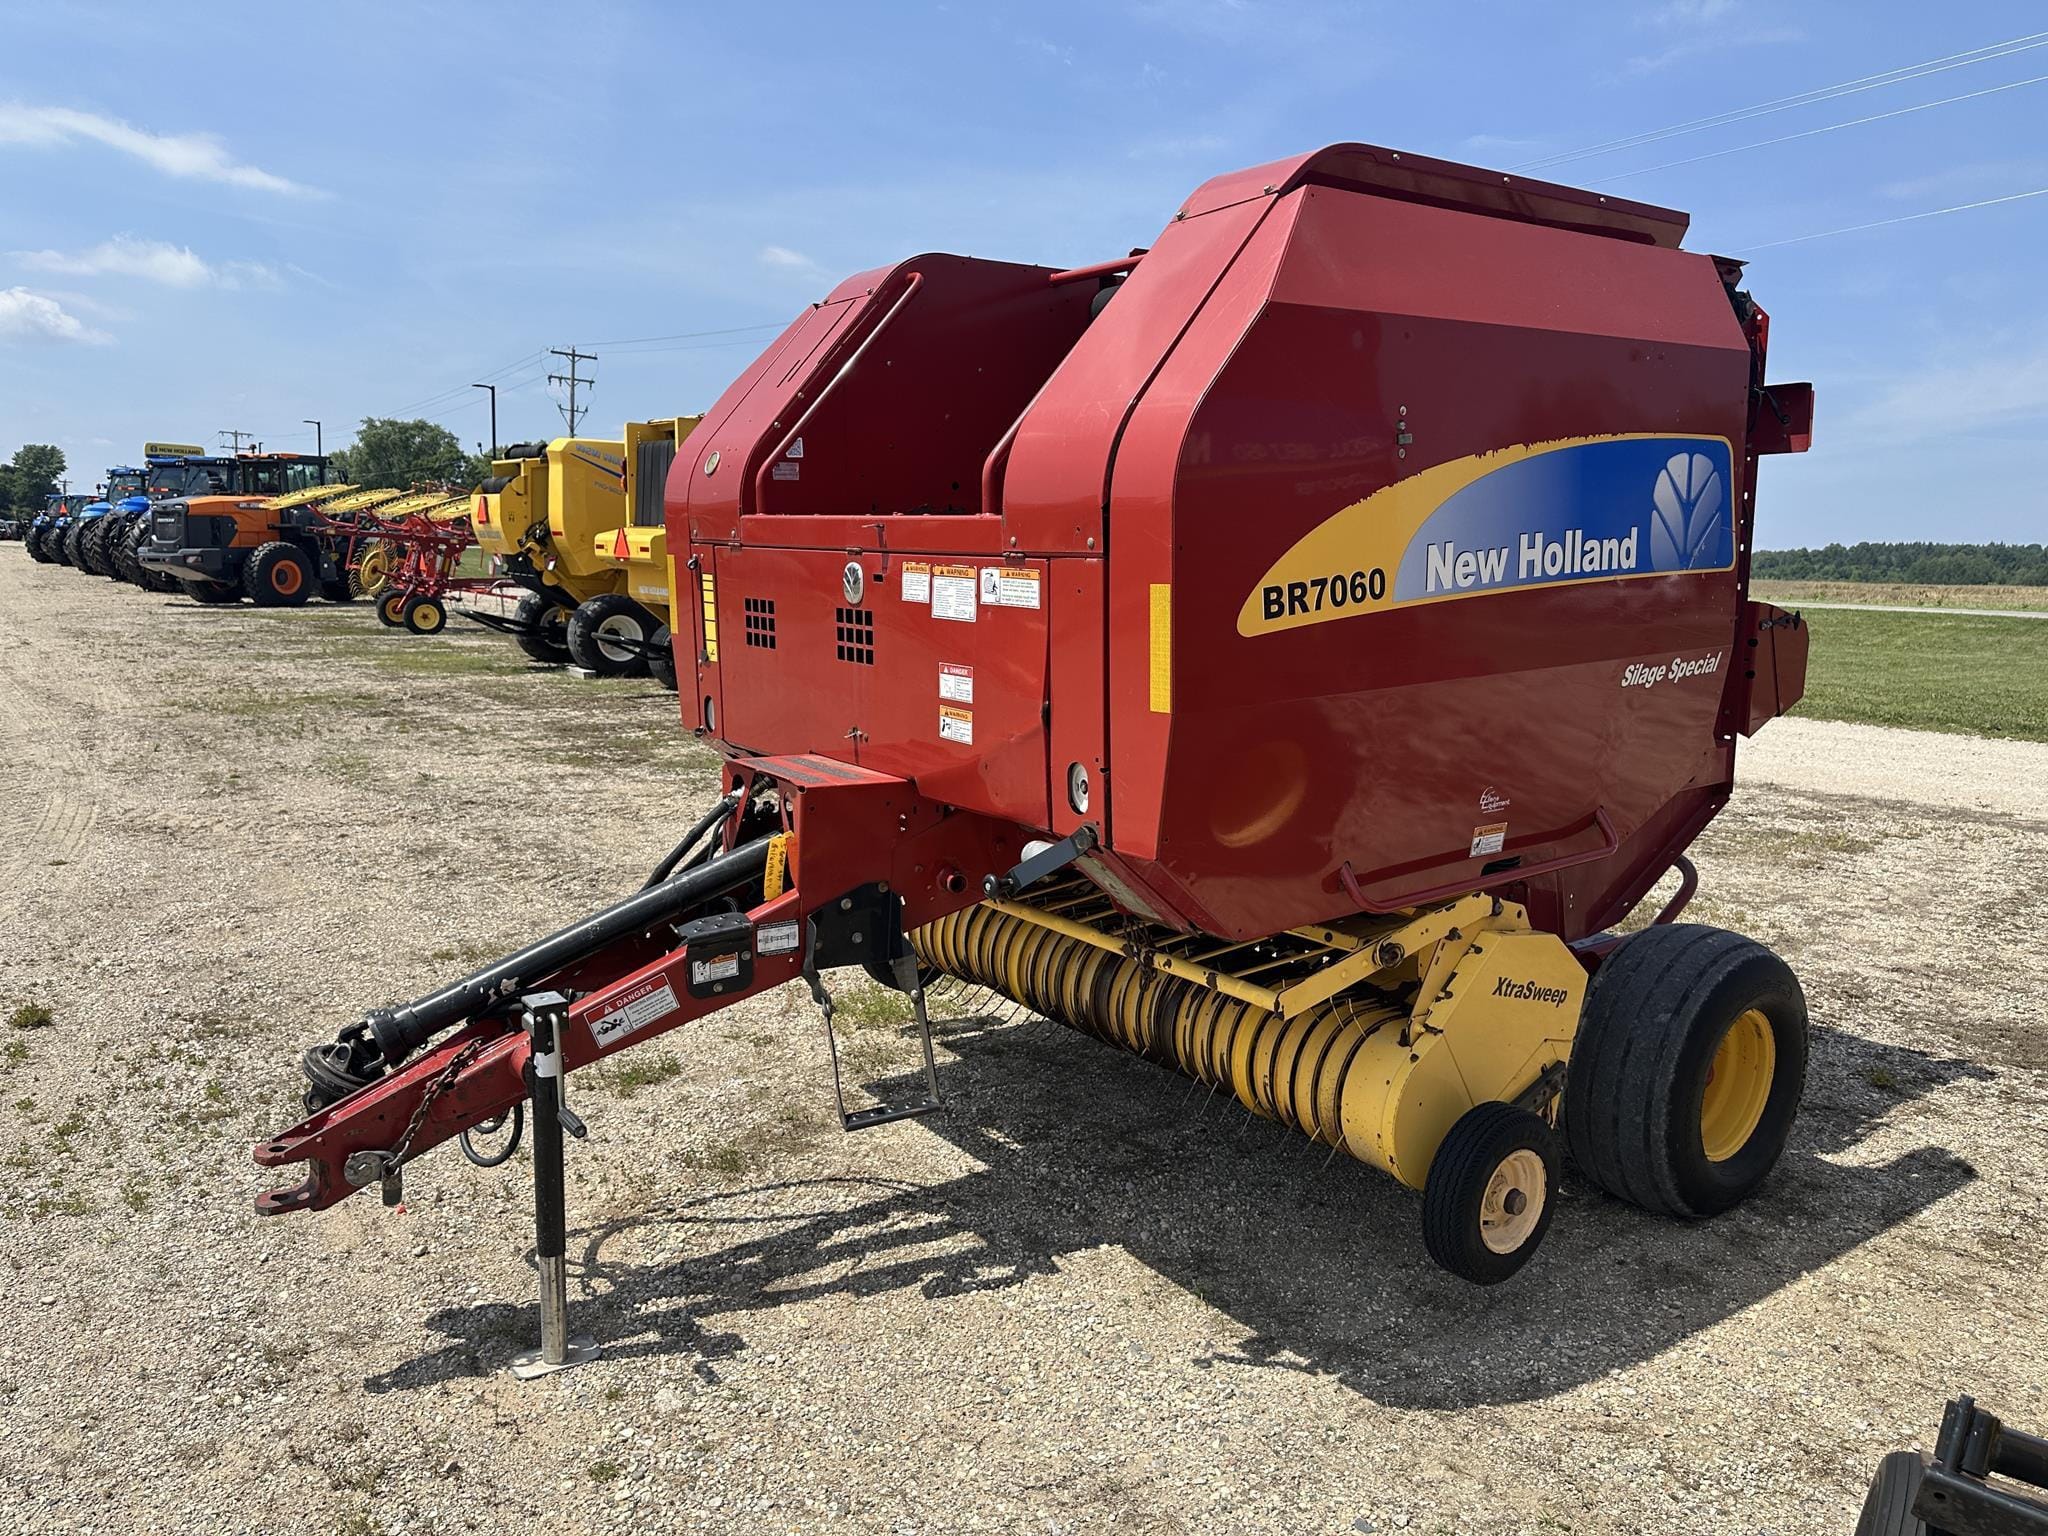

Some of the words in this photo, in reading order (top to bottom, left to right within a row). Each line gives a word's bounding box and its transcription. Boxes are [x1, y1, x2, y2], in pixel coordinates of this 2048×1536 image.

[946, 568, 970, 577] WARNING
[1425, 541, 1508, 592] New
[1518, 526, 1639, 580] Holland
[1263, 567, 1386, 621] BR7060
[949, 667, 969, 676] DANGER
[1621, 663, 1667, 688] Silage
[1668, 651, 1722, 684] Special
[615, 984, 654, 1007] DANGER
[1491, 976, 1568, 1008] XtraSweep
